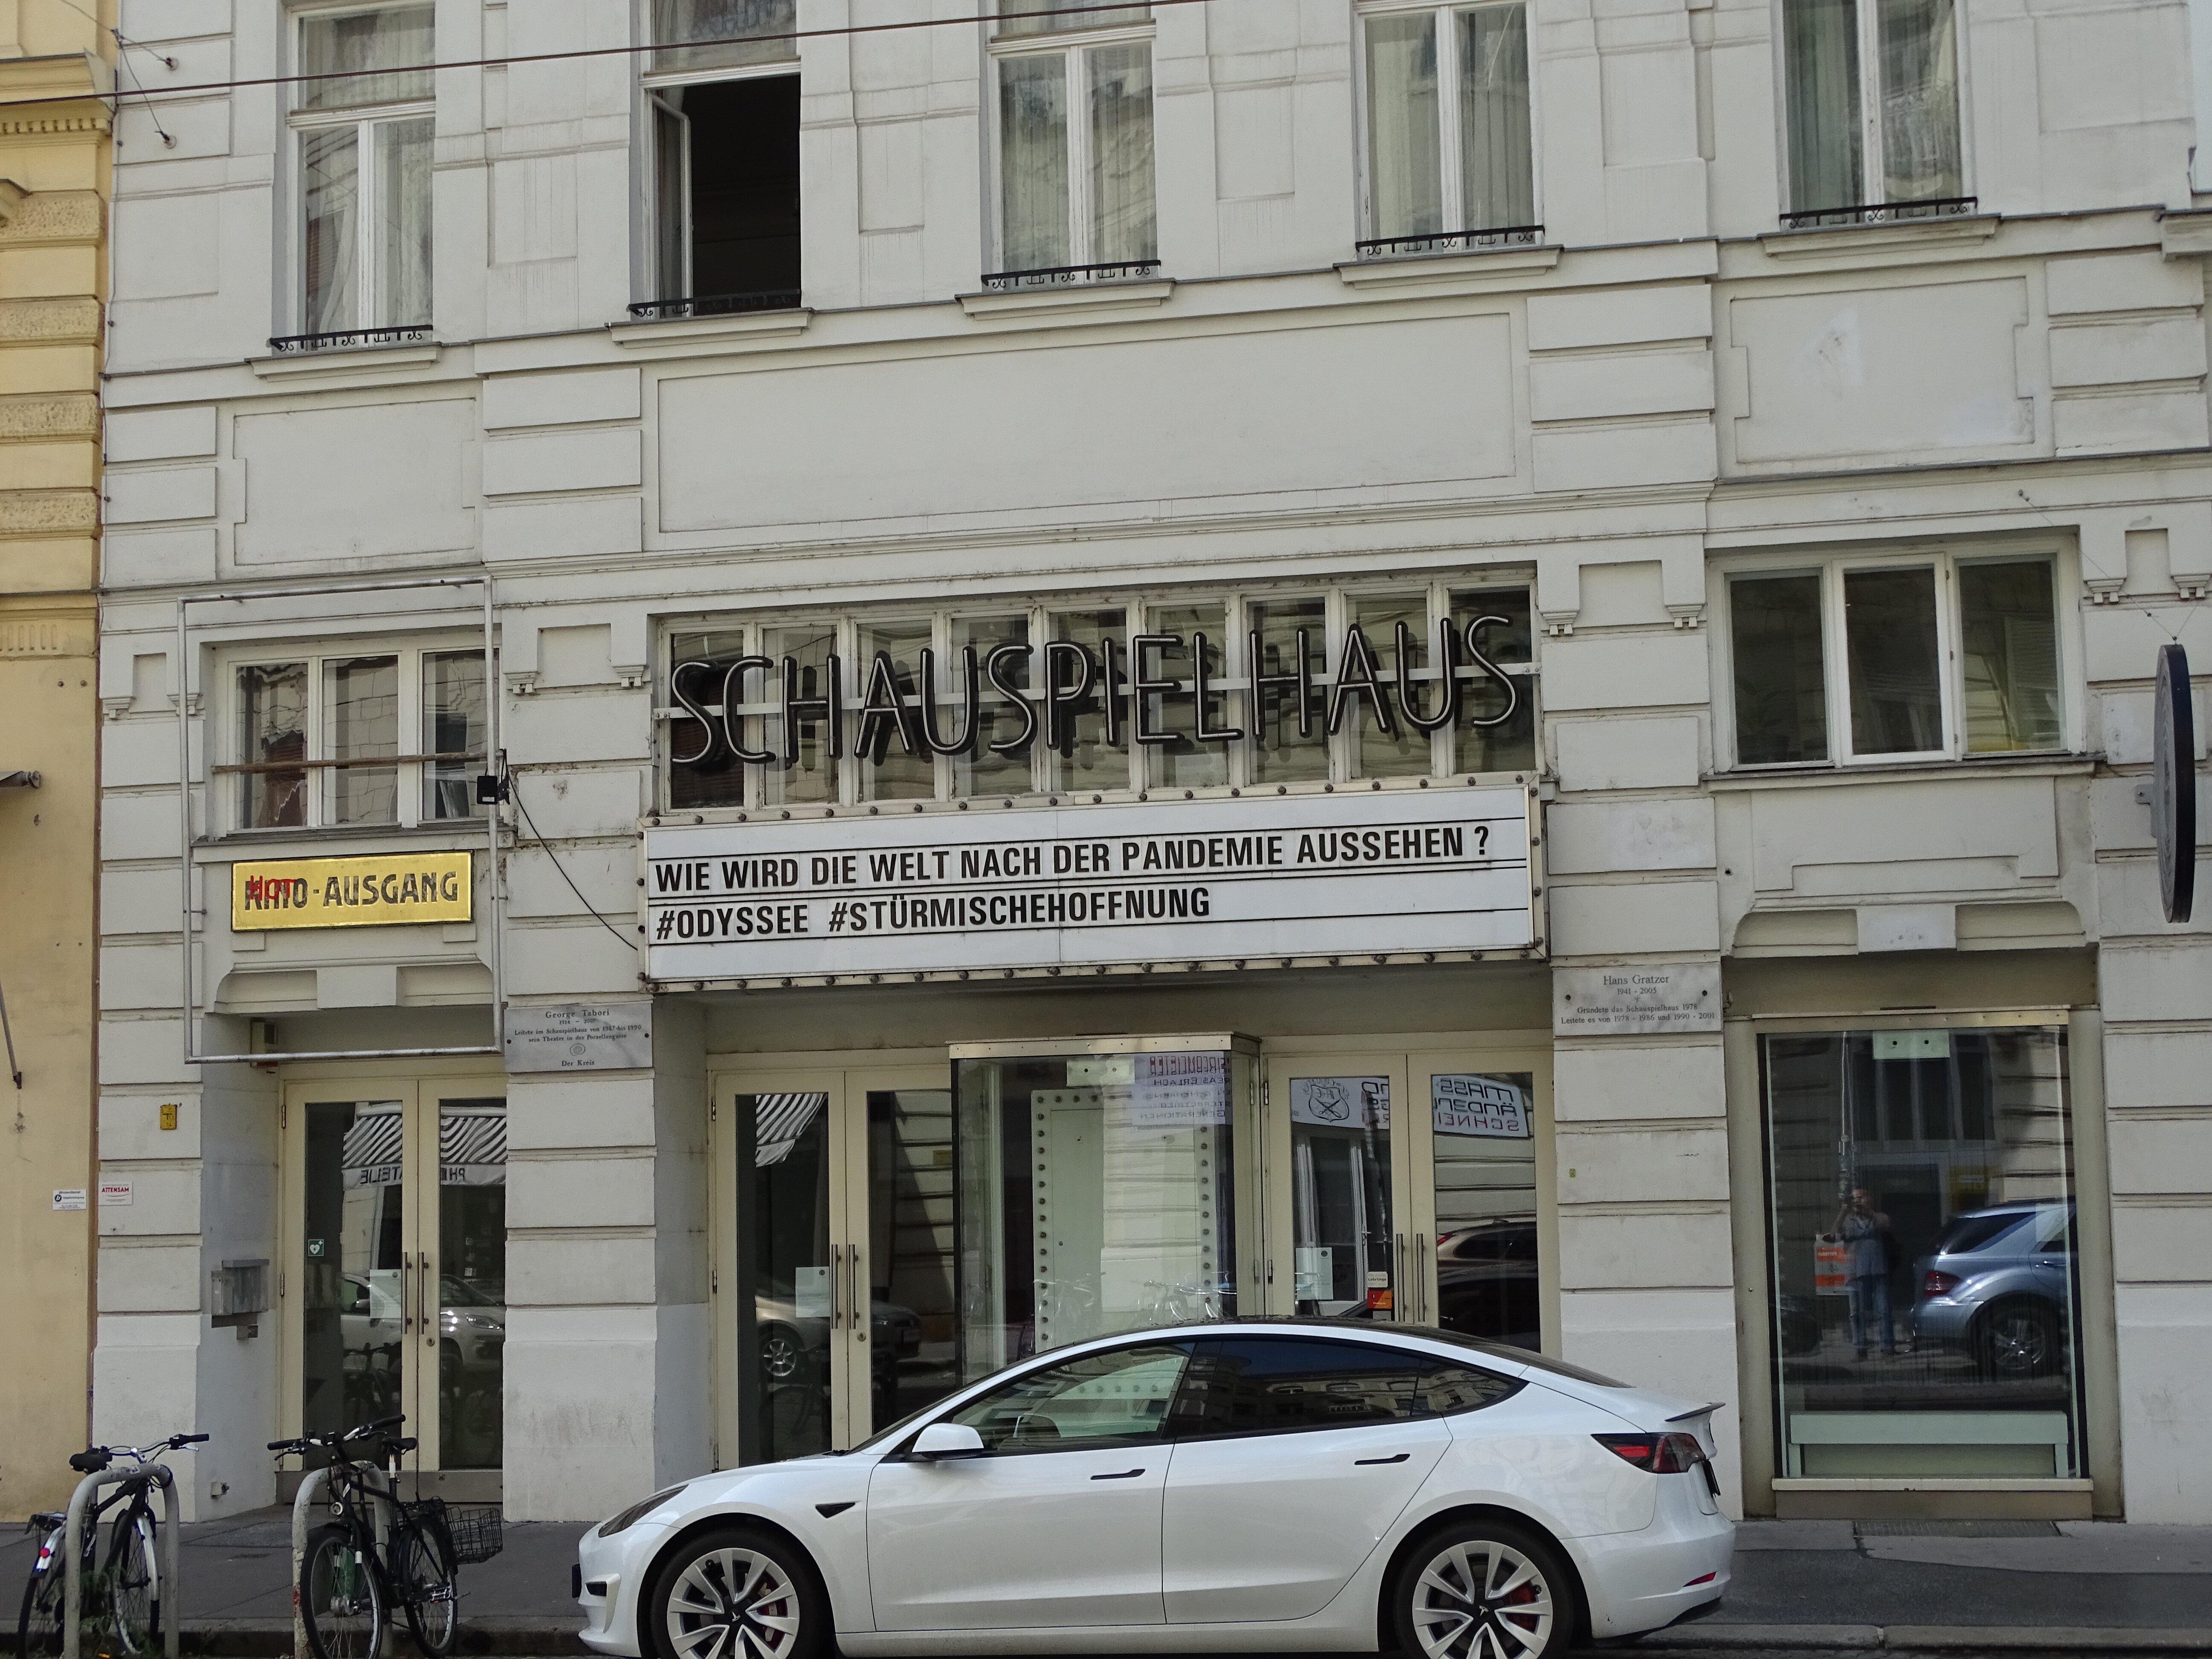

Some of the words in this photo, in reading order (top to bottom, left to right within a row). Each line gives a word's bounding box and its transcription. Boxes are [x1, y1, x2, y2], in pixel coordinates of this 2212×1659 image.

[671, 614, 1520, 766] SCHAUSPIELHAUS
[655, 863, 710, 892] WIE
[722, 859, 799, 889] WIRD
[811, 856, 856, 885] DIE
[869, 851, 949, 883] WELT
[960, 846, 1041, 879] NACH
[1053, 843, 1110, 874] DER
[1122, 835, 1282, 871] PANDEMIE
[1297, 827, 1463, 864] AUSSEHEN
[1474, 826, 1489, 856] ?
[656, 904, 808, 940] #ODYSSEE
[829, 887, 1210, 932] #STÜRMISCHEHOFFNUNG
[1603, 975, 1628, 985] Hans
[1632, 975, 1669, 984] Gratzer
[545, 1011, 575, 1019] George
[582, 1009, 609, 1017] Tabori
[1626, 1004, 1679, 1013] Schauspielhaus
